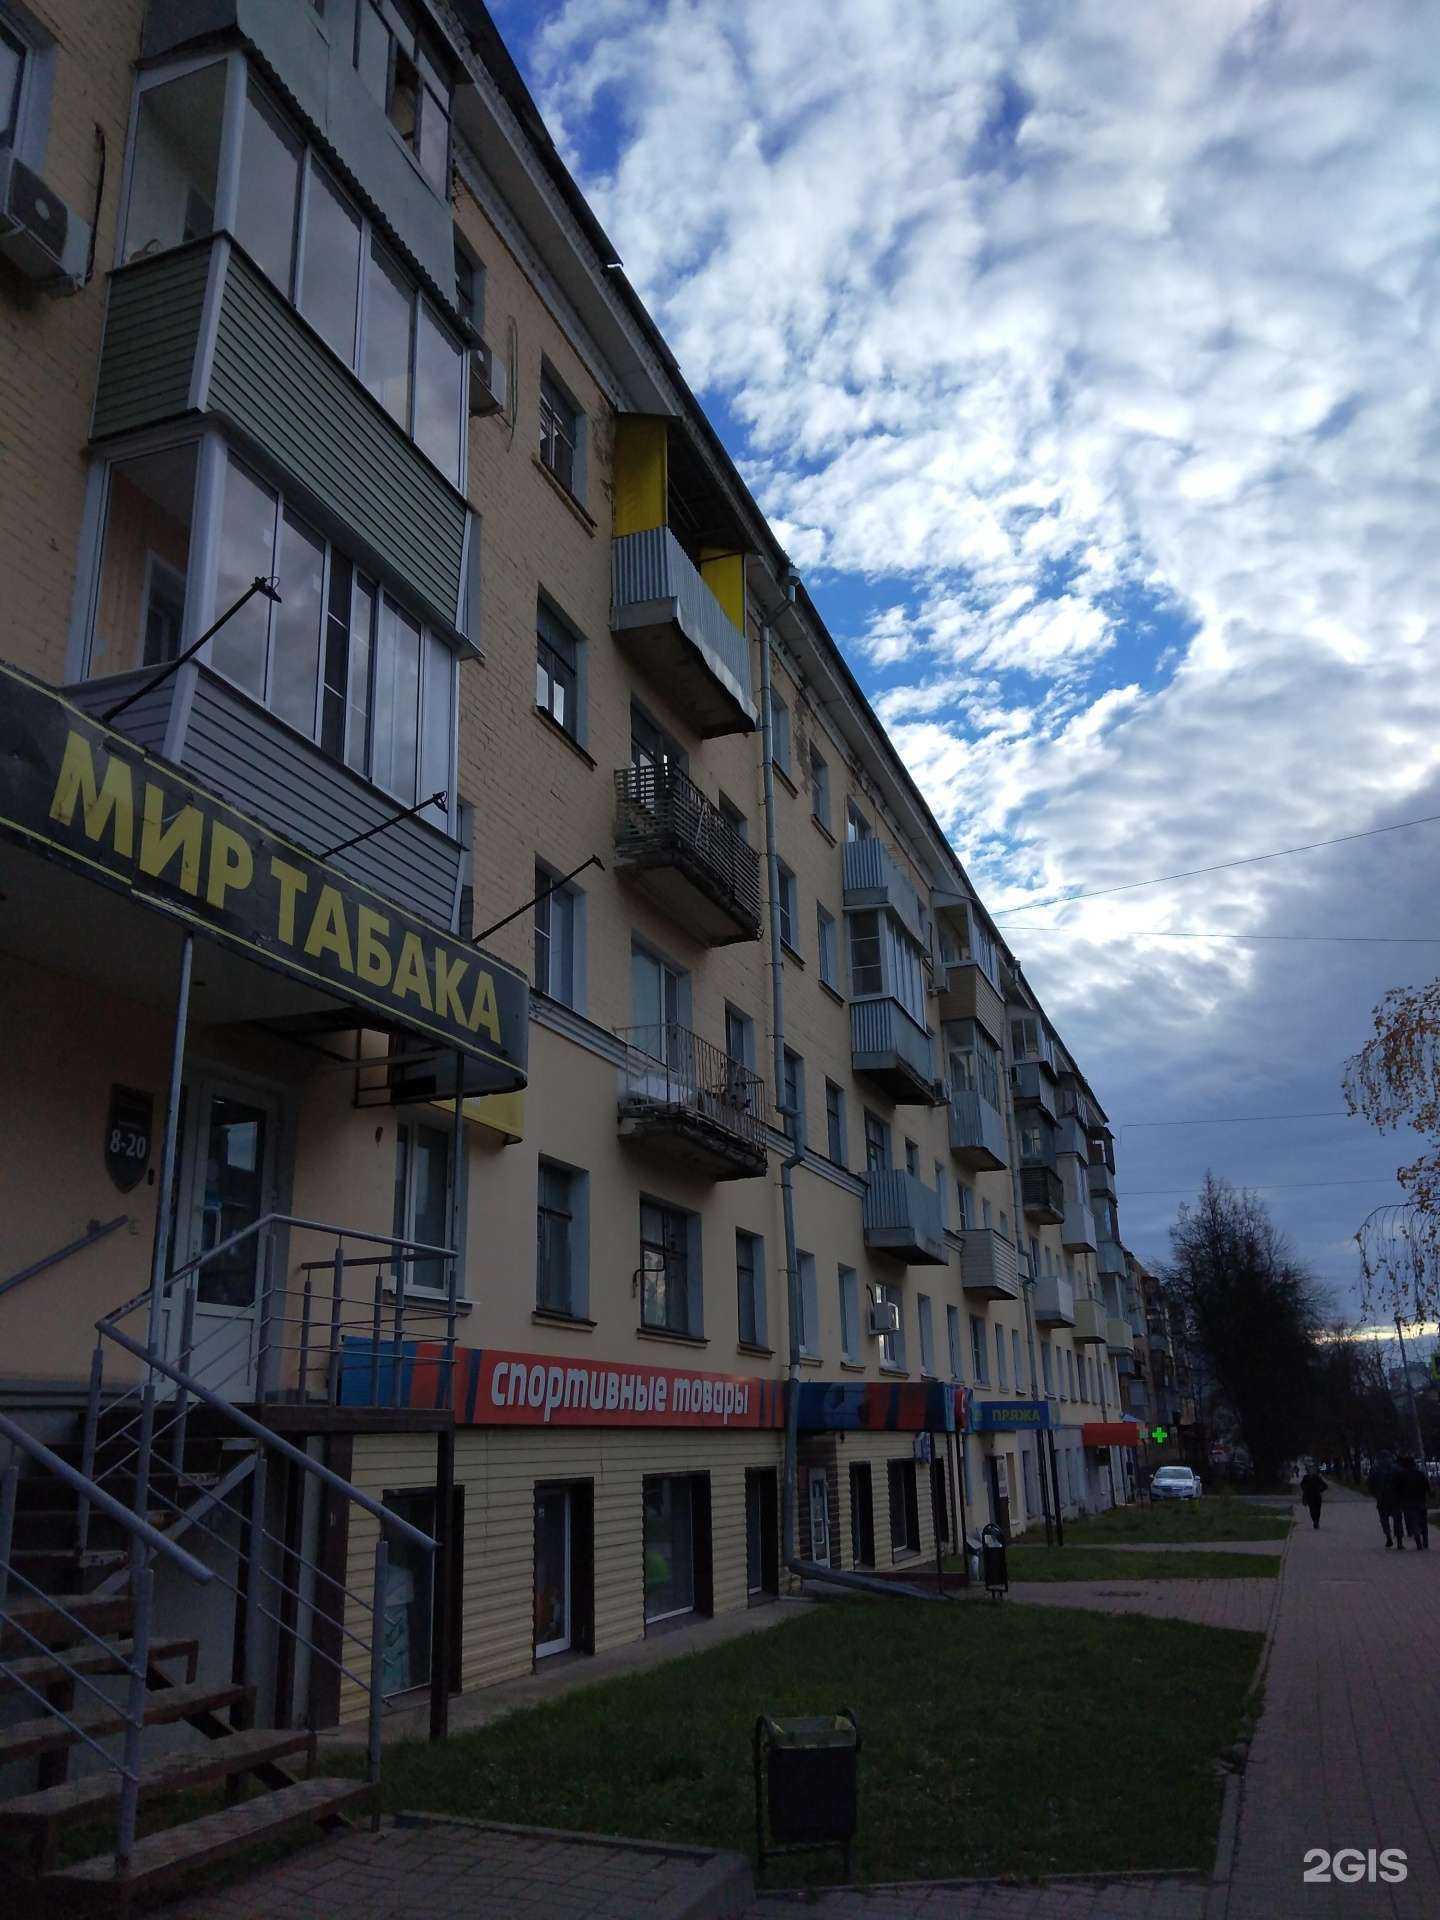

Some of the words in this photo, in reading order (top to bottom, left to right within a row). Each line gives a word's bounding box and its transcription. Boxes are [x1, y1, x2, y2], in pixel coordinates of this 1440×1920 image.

[49, 731, 254, 909] МИР
[271, 860, 502, 1044] ТАБАКА
[111, 1129, 146, 1159] 8-20
[491, 1361, 667, 1422] спортивные
[672, 1374, 749, 1425] товары
[991, 1407, 1041, 1423] ПРЯЖА
